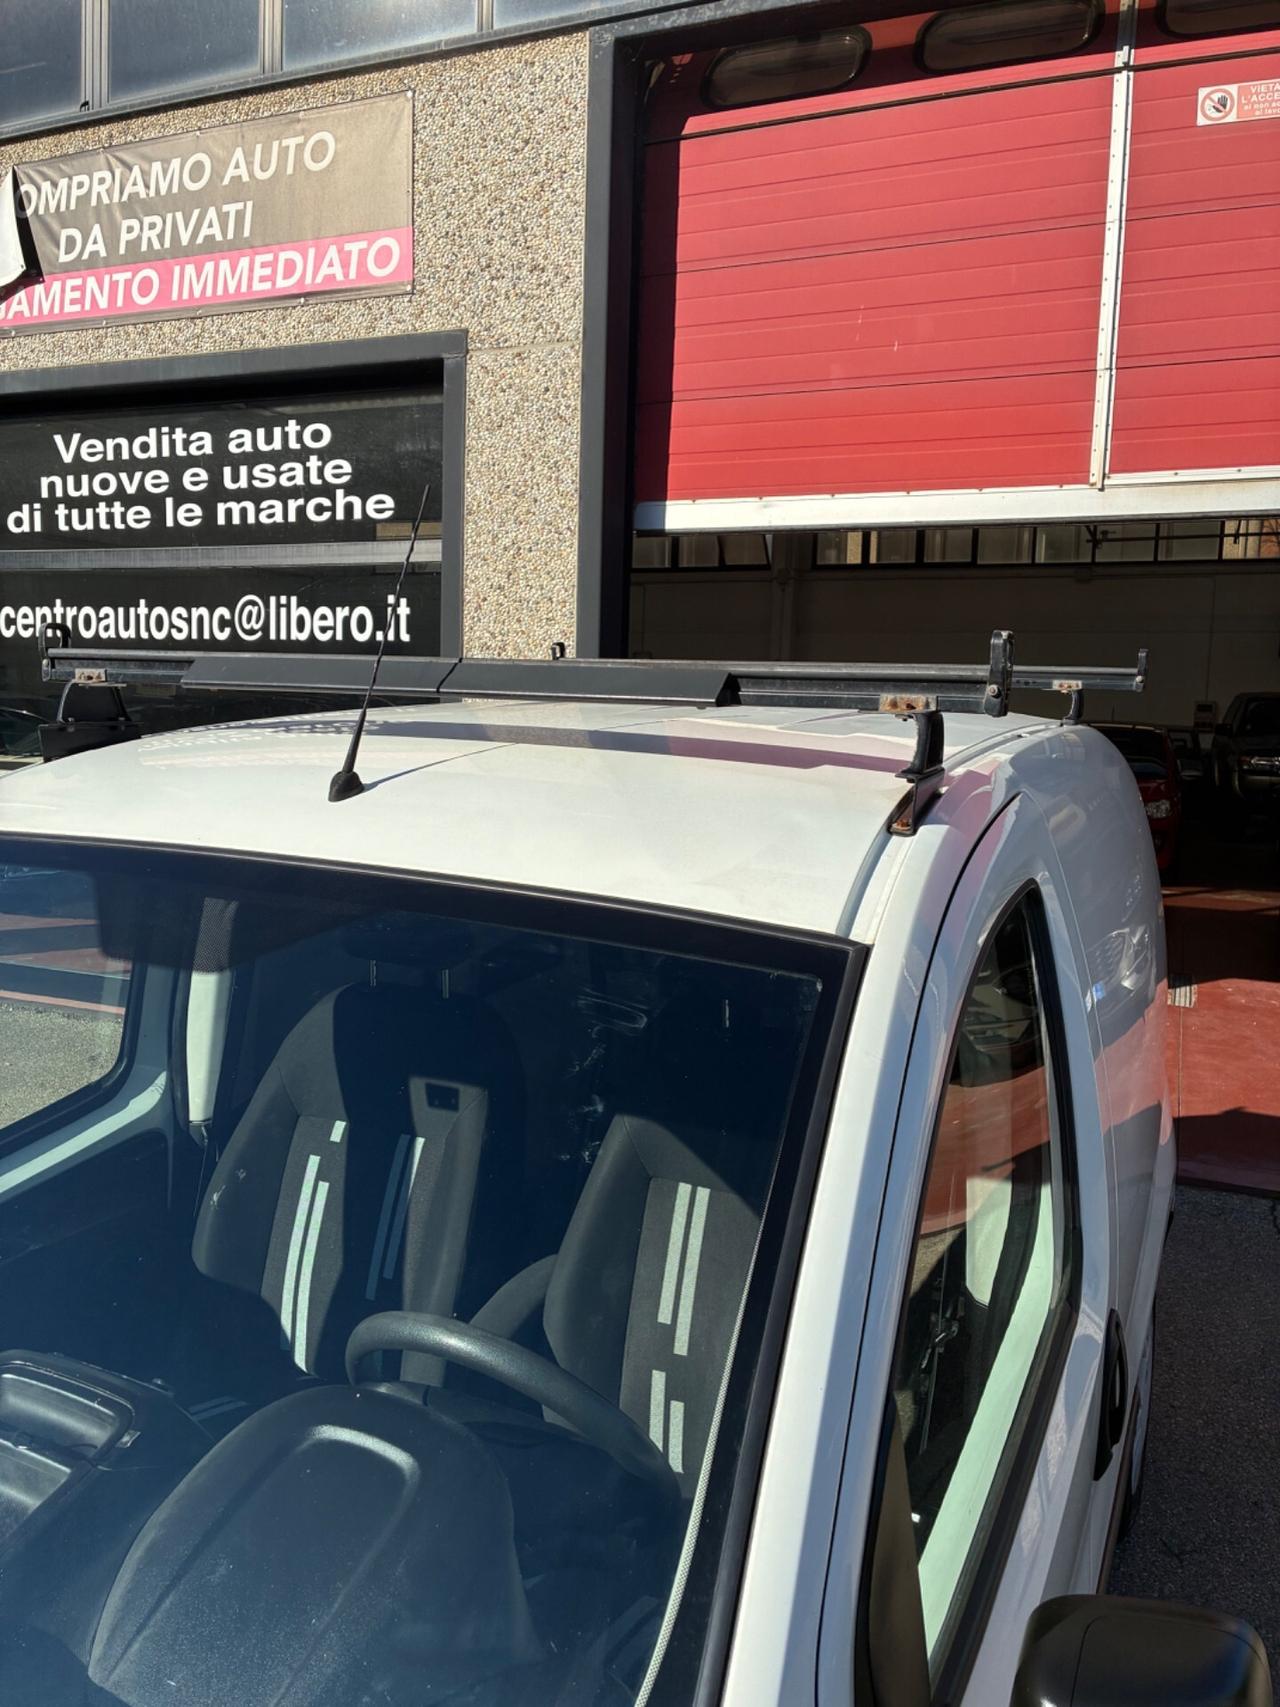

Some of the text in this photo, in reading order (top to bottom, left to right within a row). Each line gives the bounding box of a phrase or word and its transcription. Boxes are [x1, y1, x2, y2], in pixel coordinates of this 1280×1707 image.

[14, 132, 335, 218] OMPRIAMO AUTO
[59, 201, 253, 262] DA PRIVATI
[0, 237, 400, 319] AMENTO IMMEDIATO
[53, 419, 332, 463] Vendita auto
[41, 454, 352, 498] nuove e usate
[7, 489, 395, 533] di tutte le marche
[0, 594, 411, 642] centroautosnc@libero.it
